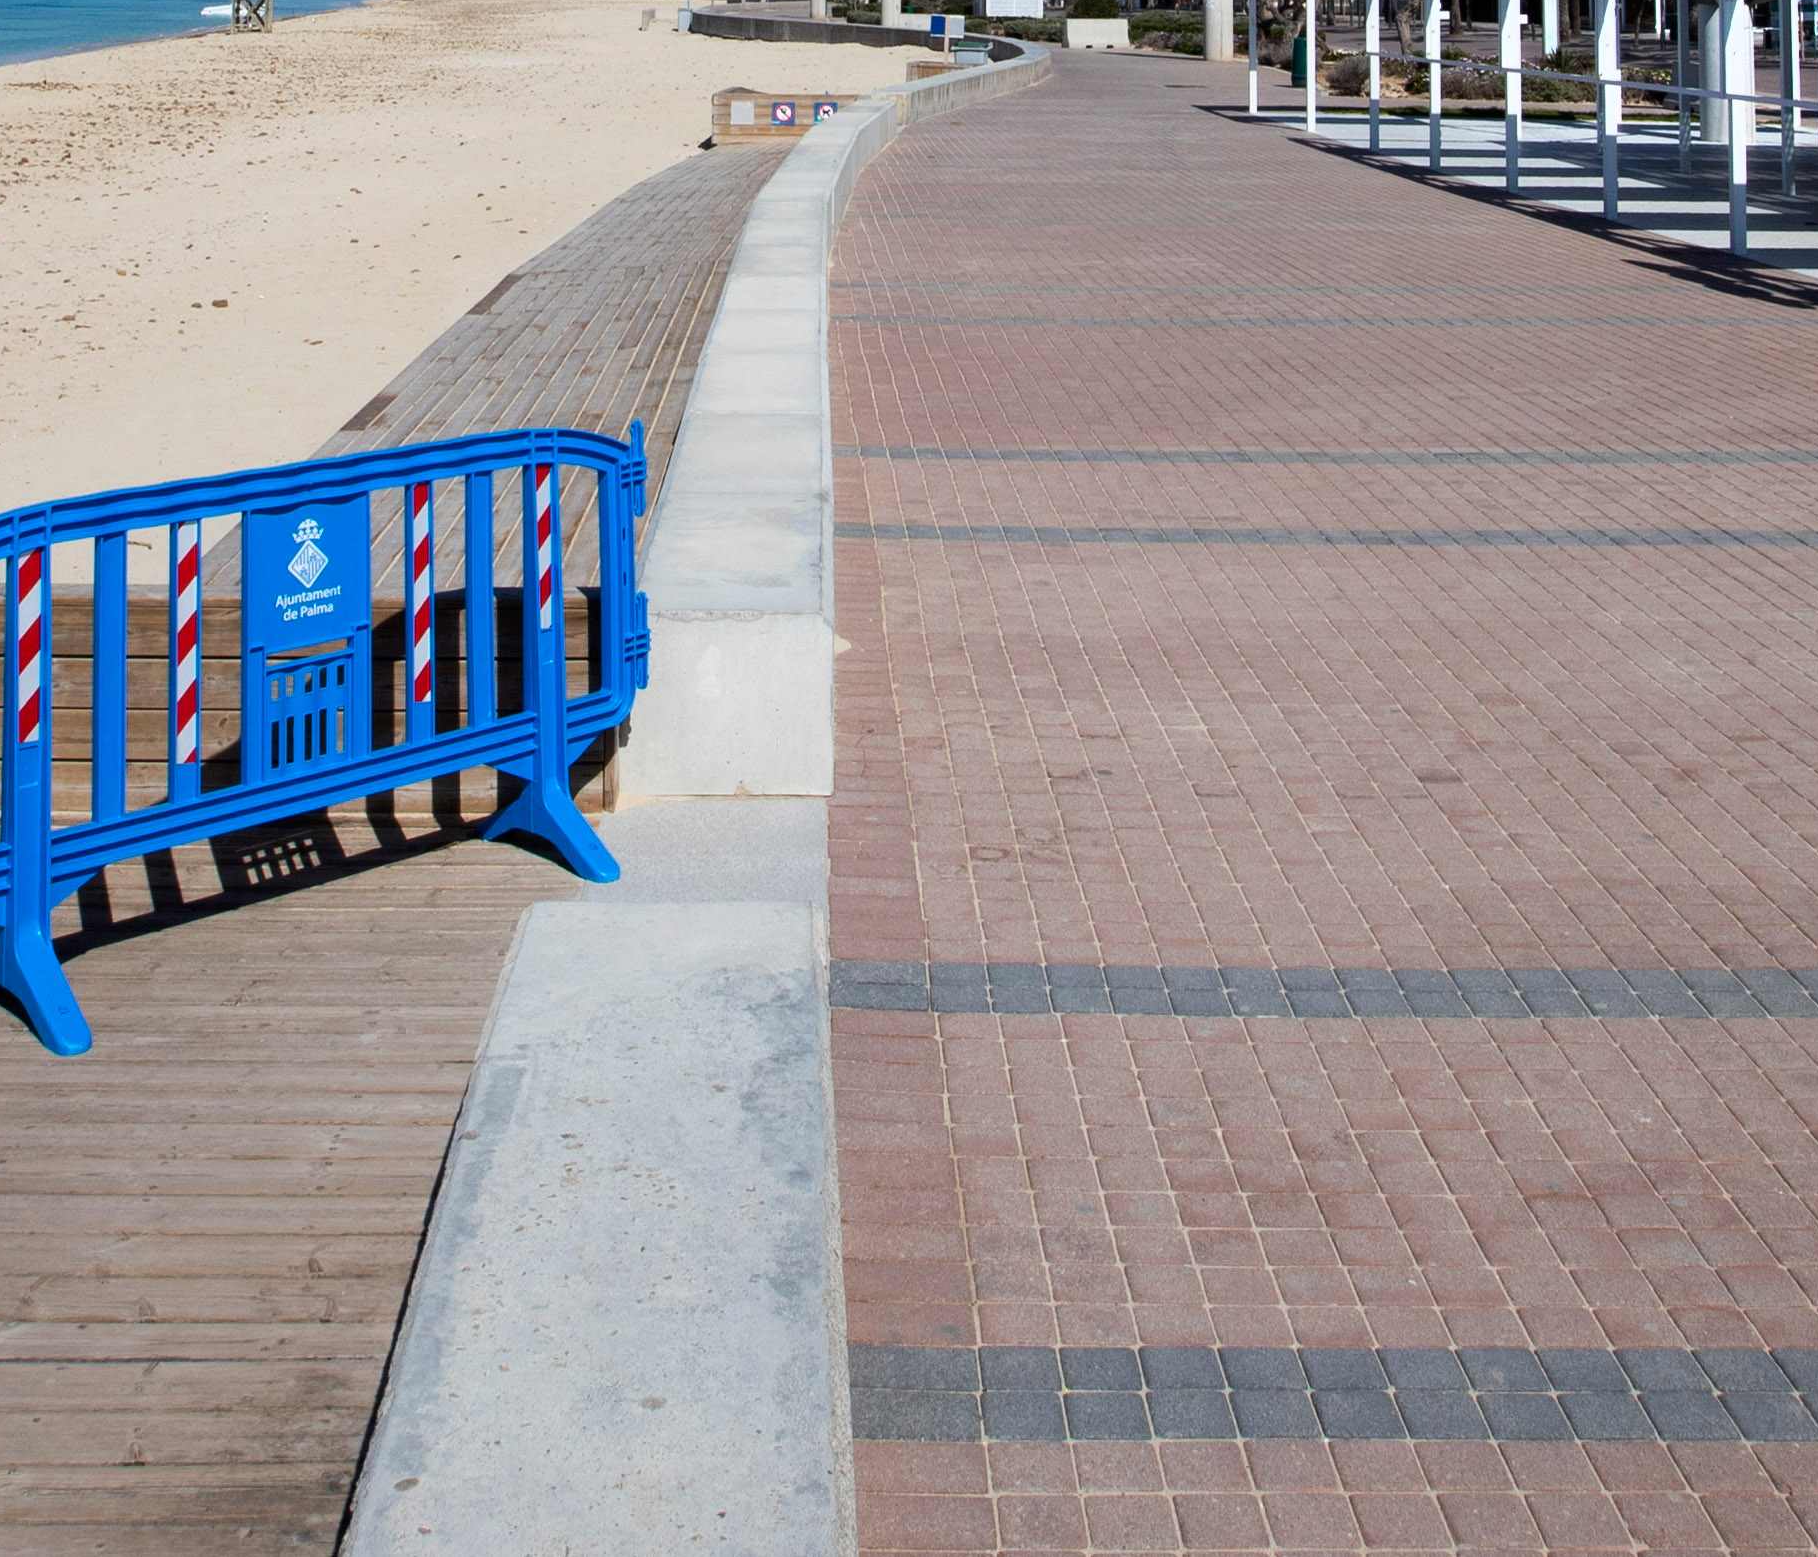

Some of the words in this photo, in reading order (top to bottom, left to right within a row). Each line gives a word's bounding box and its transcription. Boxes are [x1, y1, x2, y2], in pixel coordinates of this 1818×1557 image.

[275, 585, 342, 609] Ajuntament
[283, 609, 298, 622] de
[300, 603, 334, 618] Palma
